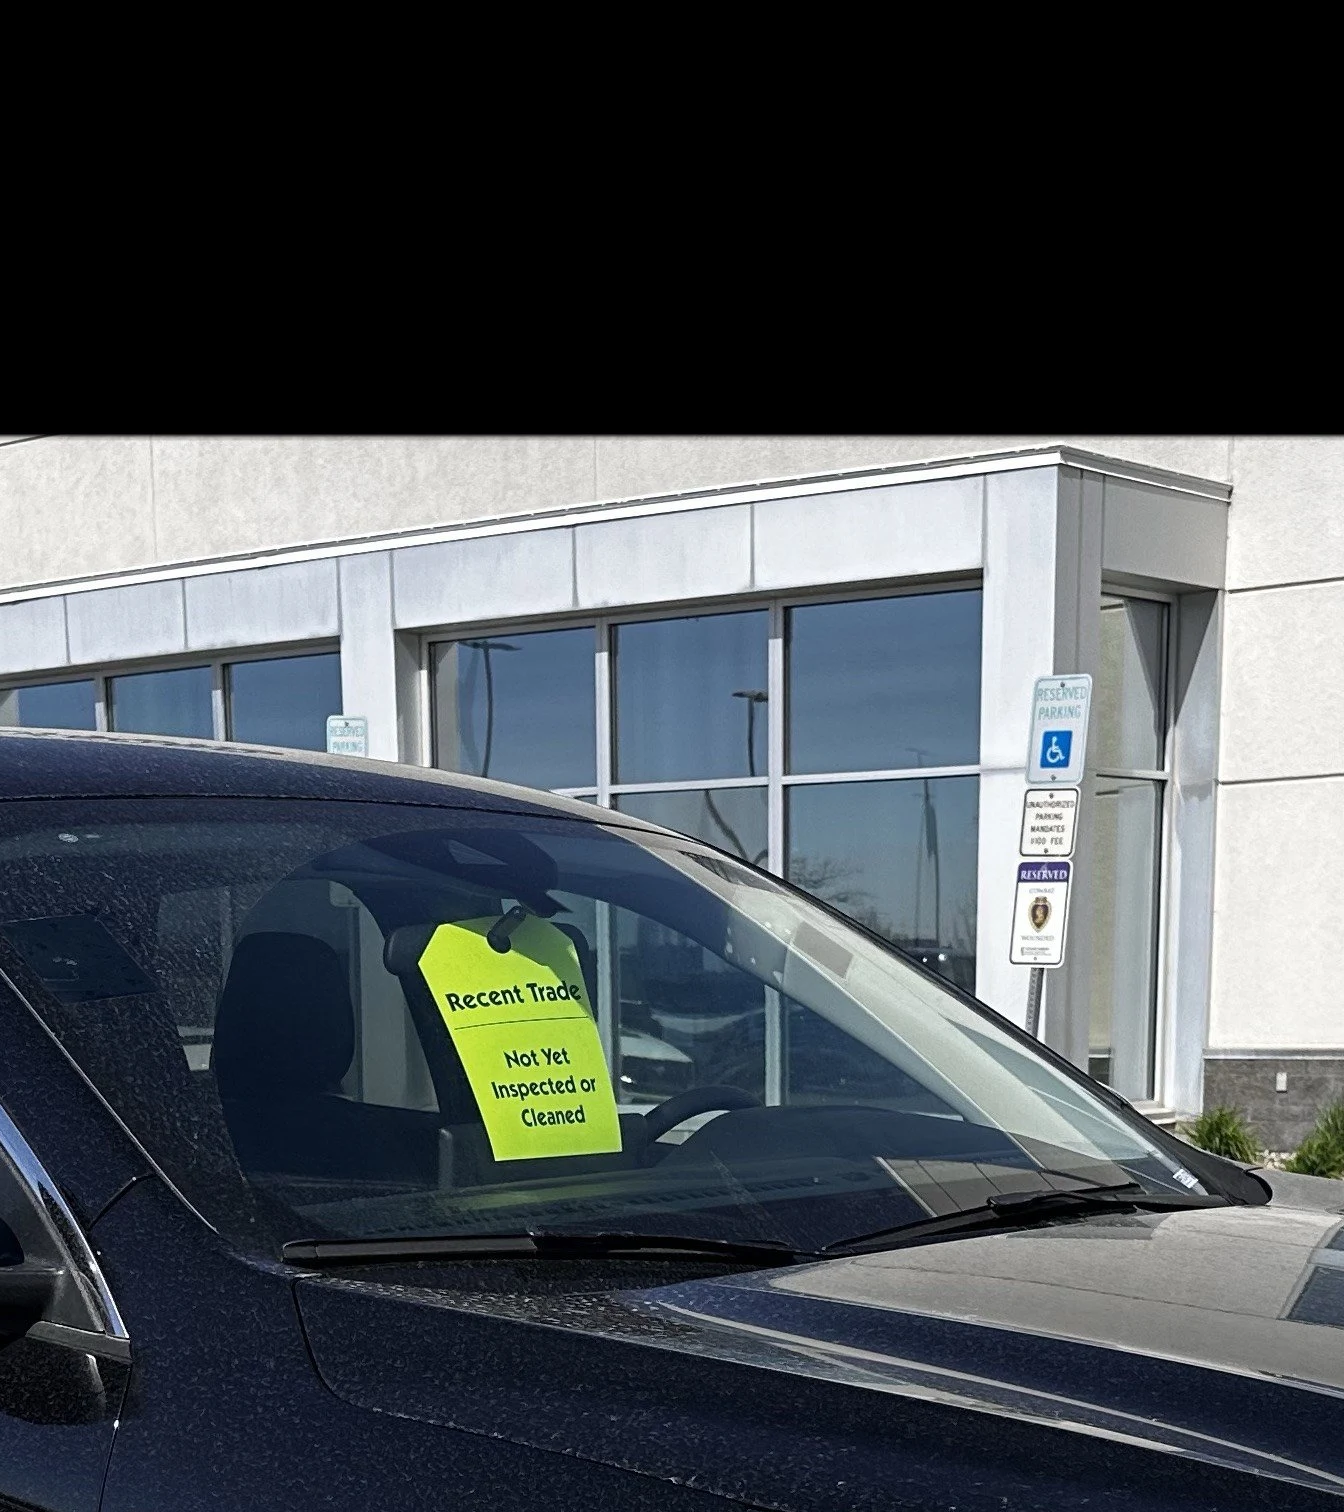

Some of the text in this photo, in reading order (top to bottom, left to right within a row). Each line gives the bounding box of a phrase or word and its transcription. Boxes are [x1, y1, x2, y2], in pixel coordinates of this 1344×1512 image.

[1037, 686, 1087, 701] RESERVED
[1038, 705, 1081, 720] PARKING
[1025, 800, 1075, 809] UNAUTHORIZED
[1035, 812, 1063, 821] PARKING
[1030, 824, 1065, 833] MANDATES
[1050, 836, 1064, 846] FEE
[1020, 869, 1068, 881] RESERVED
[445, 981, 582, 1013] Recent Trade
[503, 1047, 571, 1069] Not Yet
[491, 1074, 596, 1101] Inspected or
[521, 1104, 586, 1128] Cleaned
